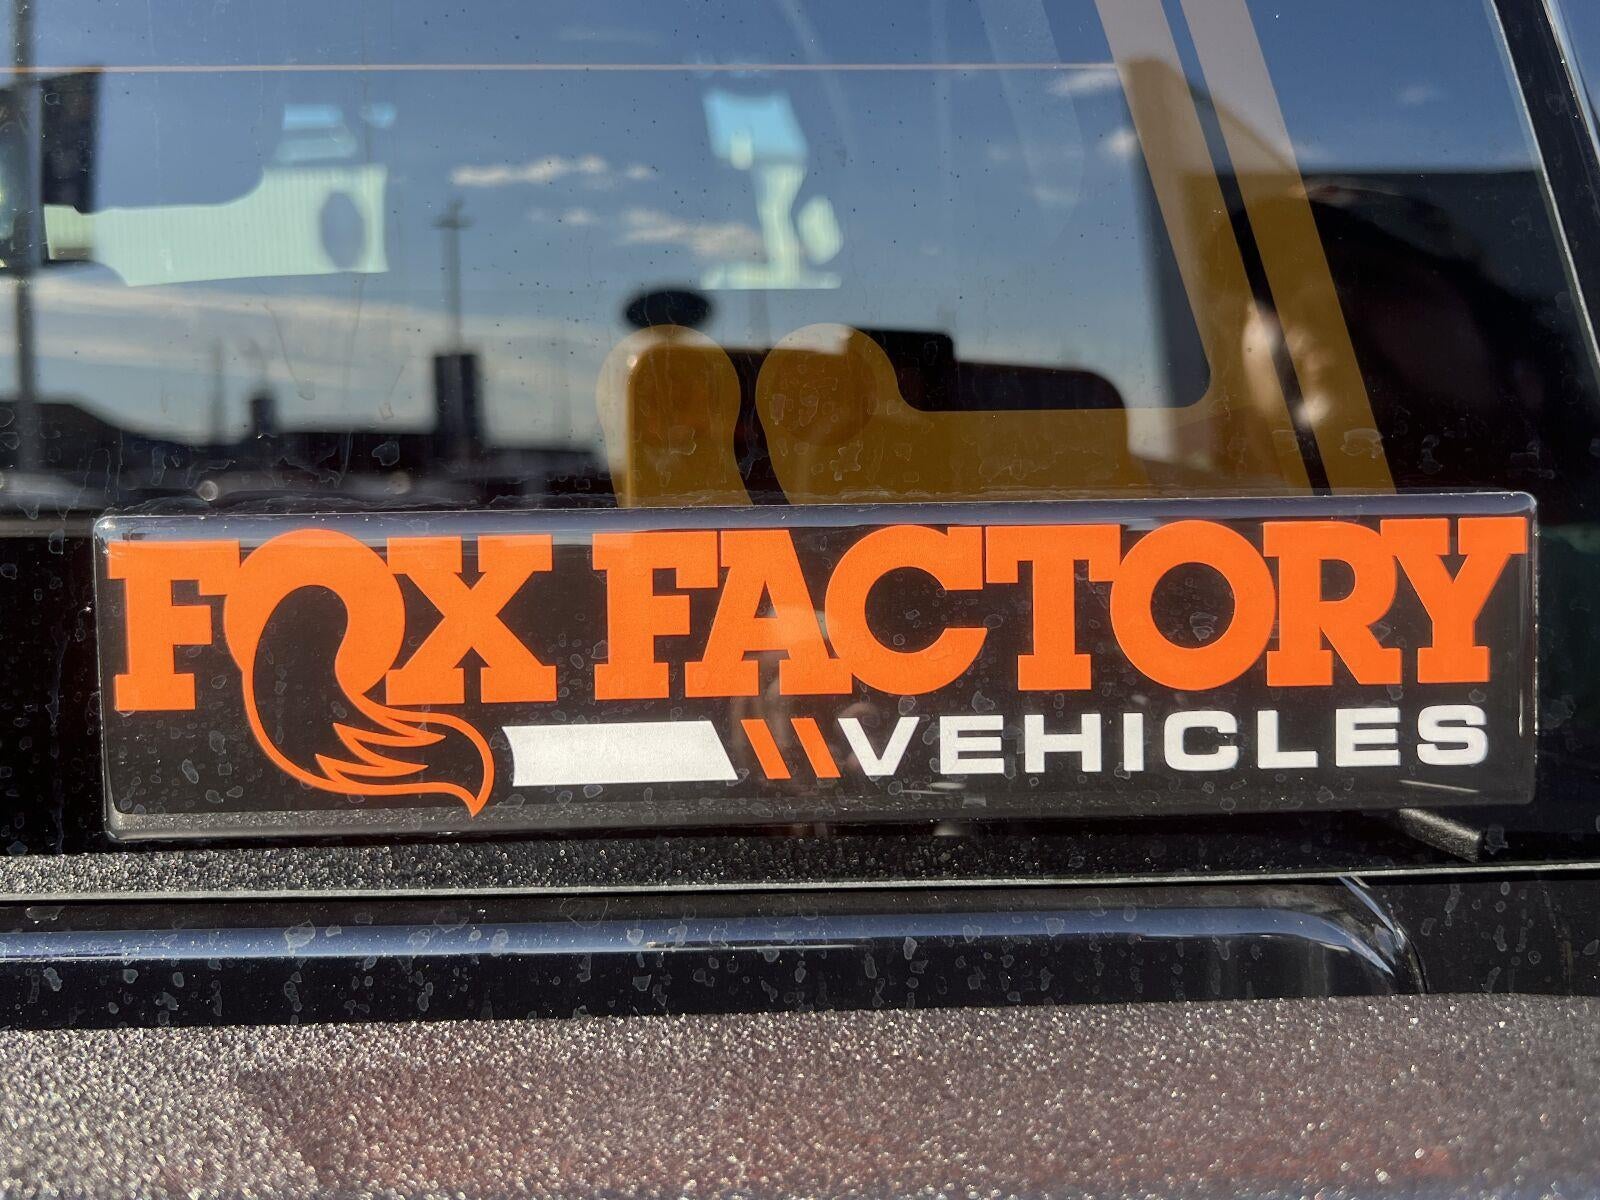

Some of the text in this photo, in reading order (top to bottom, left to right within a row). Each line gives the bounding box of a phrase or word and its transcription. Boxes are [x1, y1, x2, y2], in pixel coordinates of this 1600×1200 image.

[107, 517, 1528, 817] FOX FACTORY
[837, 704, 1488, 778] VEHICLES
